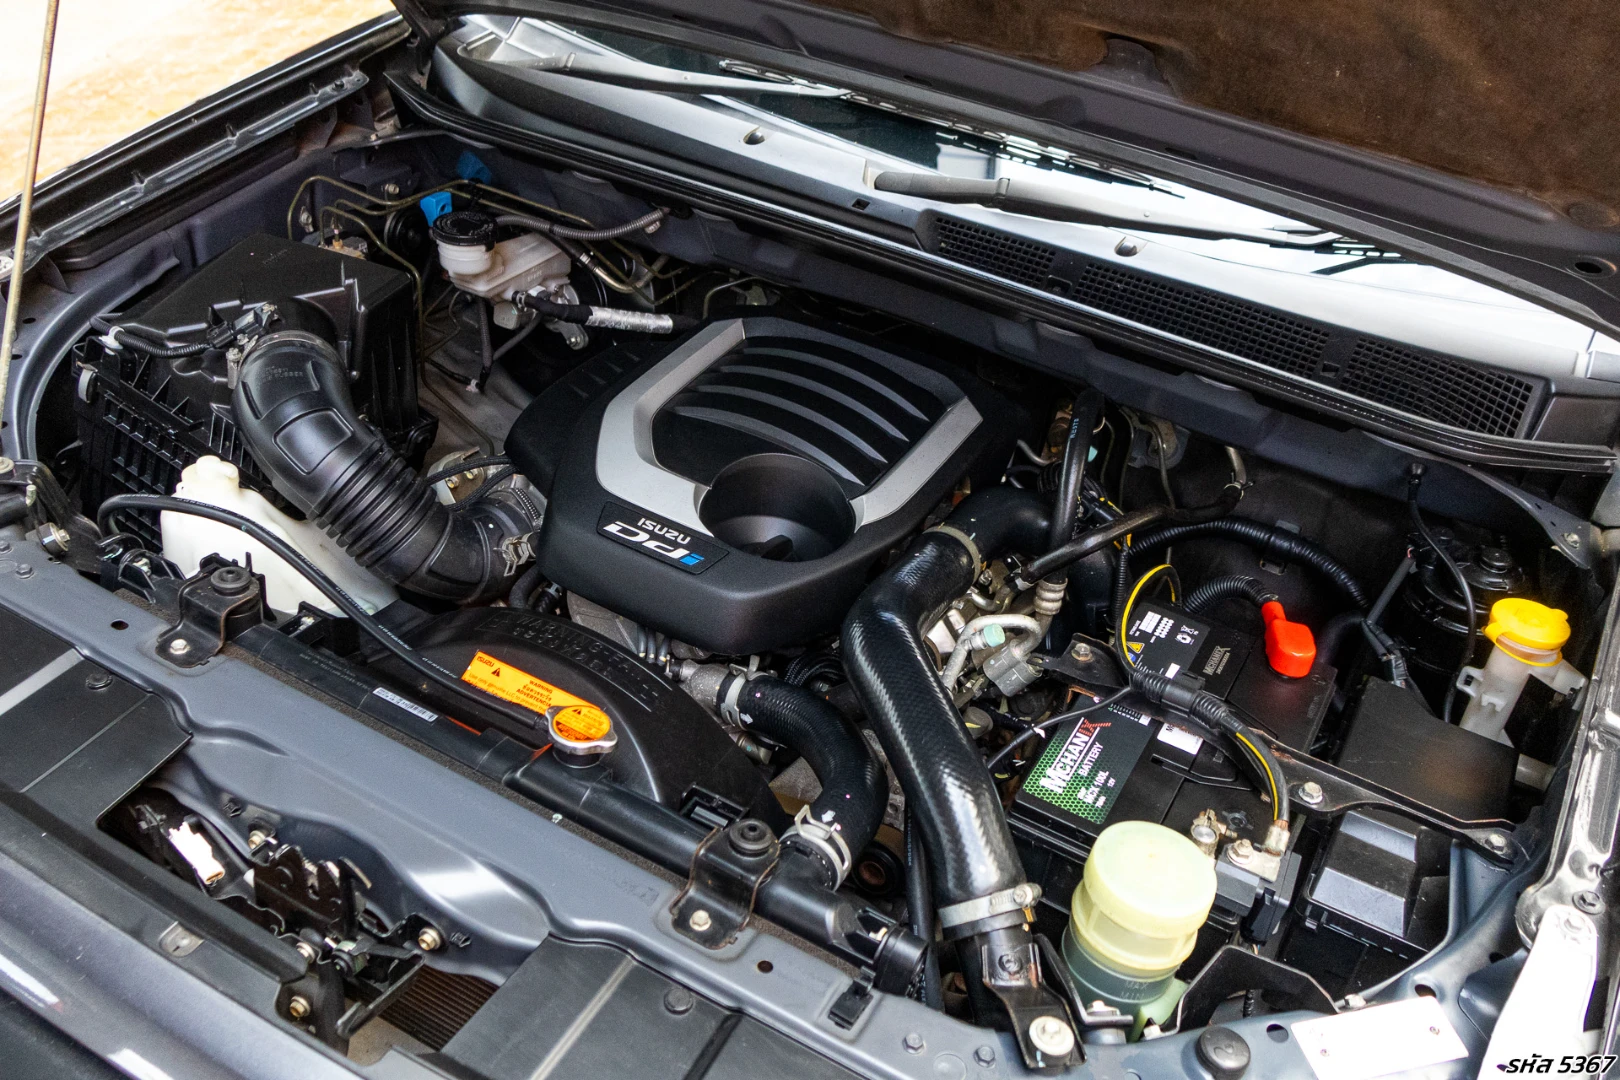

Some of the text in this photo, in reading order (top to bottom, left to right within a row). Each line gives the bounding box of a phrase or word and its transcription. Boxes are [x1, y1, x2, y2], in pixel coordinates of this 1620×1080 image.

[637, 517, 691, 545] ISUZU
[476, 655, 495, 668] ISUZU
[516, 688, 552, 708] ADVERTENCIA
[529, 680, 553, 694] WARNING
[1039, 717, 1112, 794] MCHANIX
[1077, 741, 1104, 777] BATTERY
[1084, 784, 1100, 805] MCX
[1095, 770, 1109, 787] 100L
